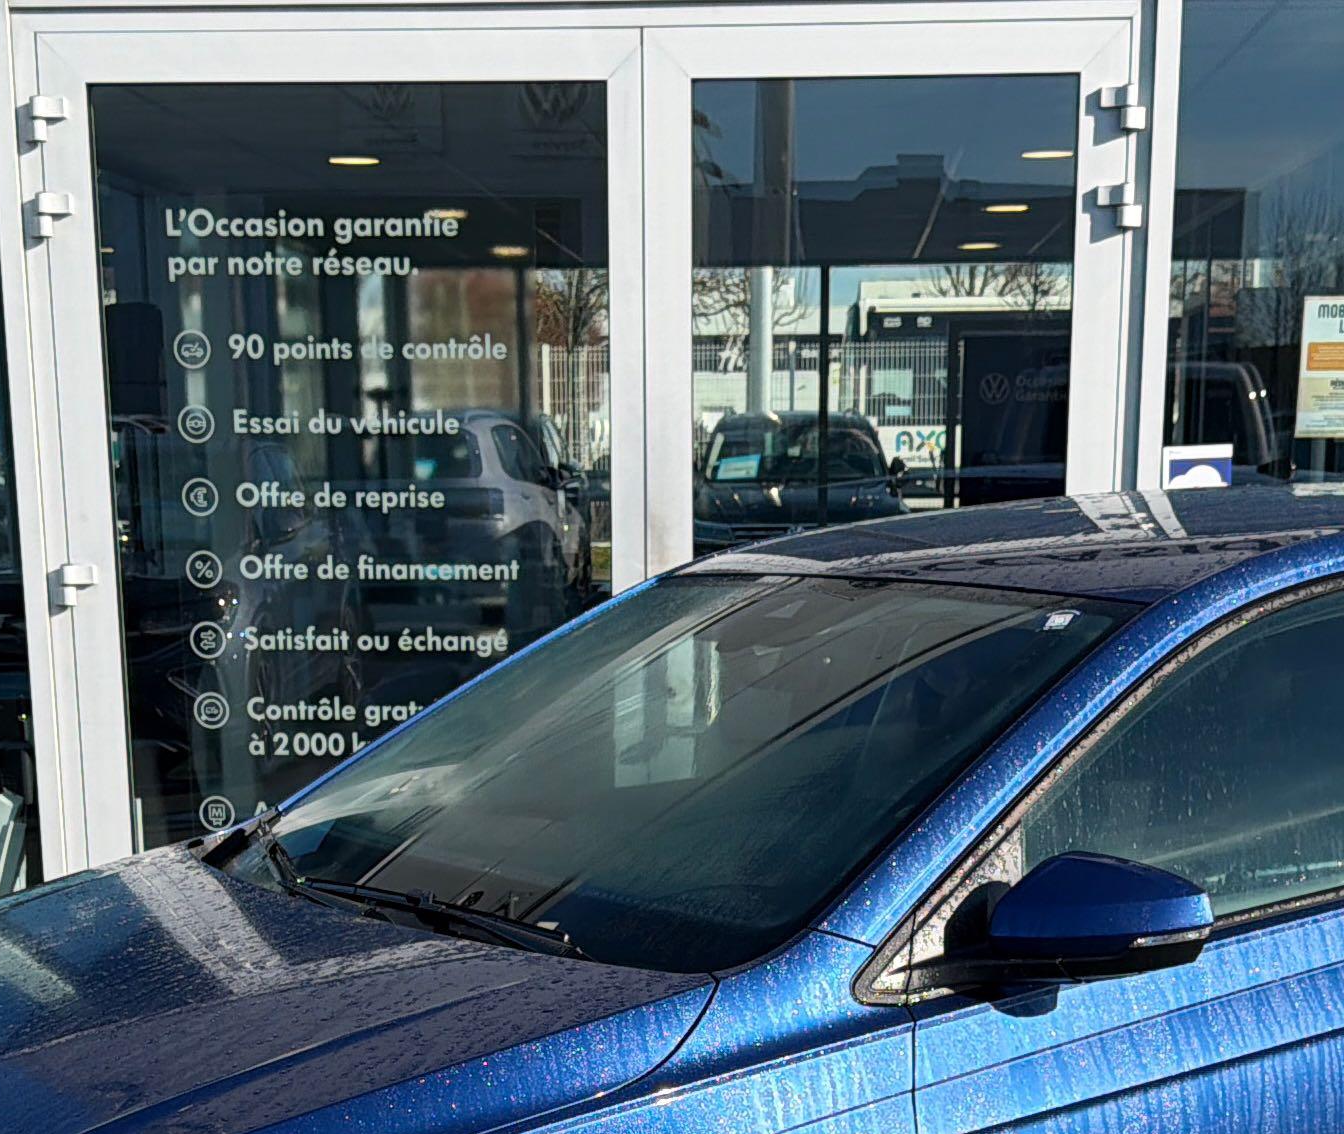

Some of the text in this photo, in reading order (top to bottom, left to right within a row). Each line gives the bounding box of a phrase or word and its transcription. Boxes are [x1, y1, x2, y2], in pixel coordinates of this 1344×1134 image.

[165, 208, 459, 244] L'Occasion garantie
[168, 248, 419, 282] par notre réseau.
[228, 333, 507, 366] 90 points de contrôle
[233, 408, 460, 435] Essai du véhicule
[235, 481, 446, 514] Offre de reprise
[239, 554, 520, 581] Offre de financement
[244, 626, 509, 658] Satisfait ou échangé
[246, 696, 424, 727] Contrôle grat
[248, 733, 266, 756] à
